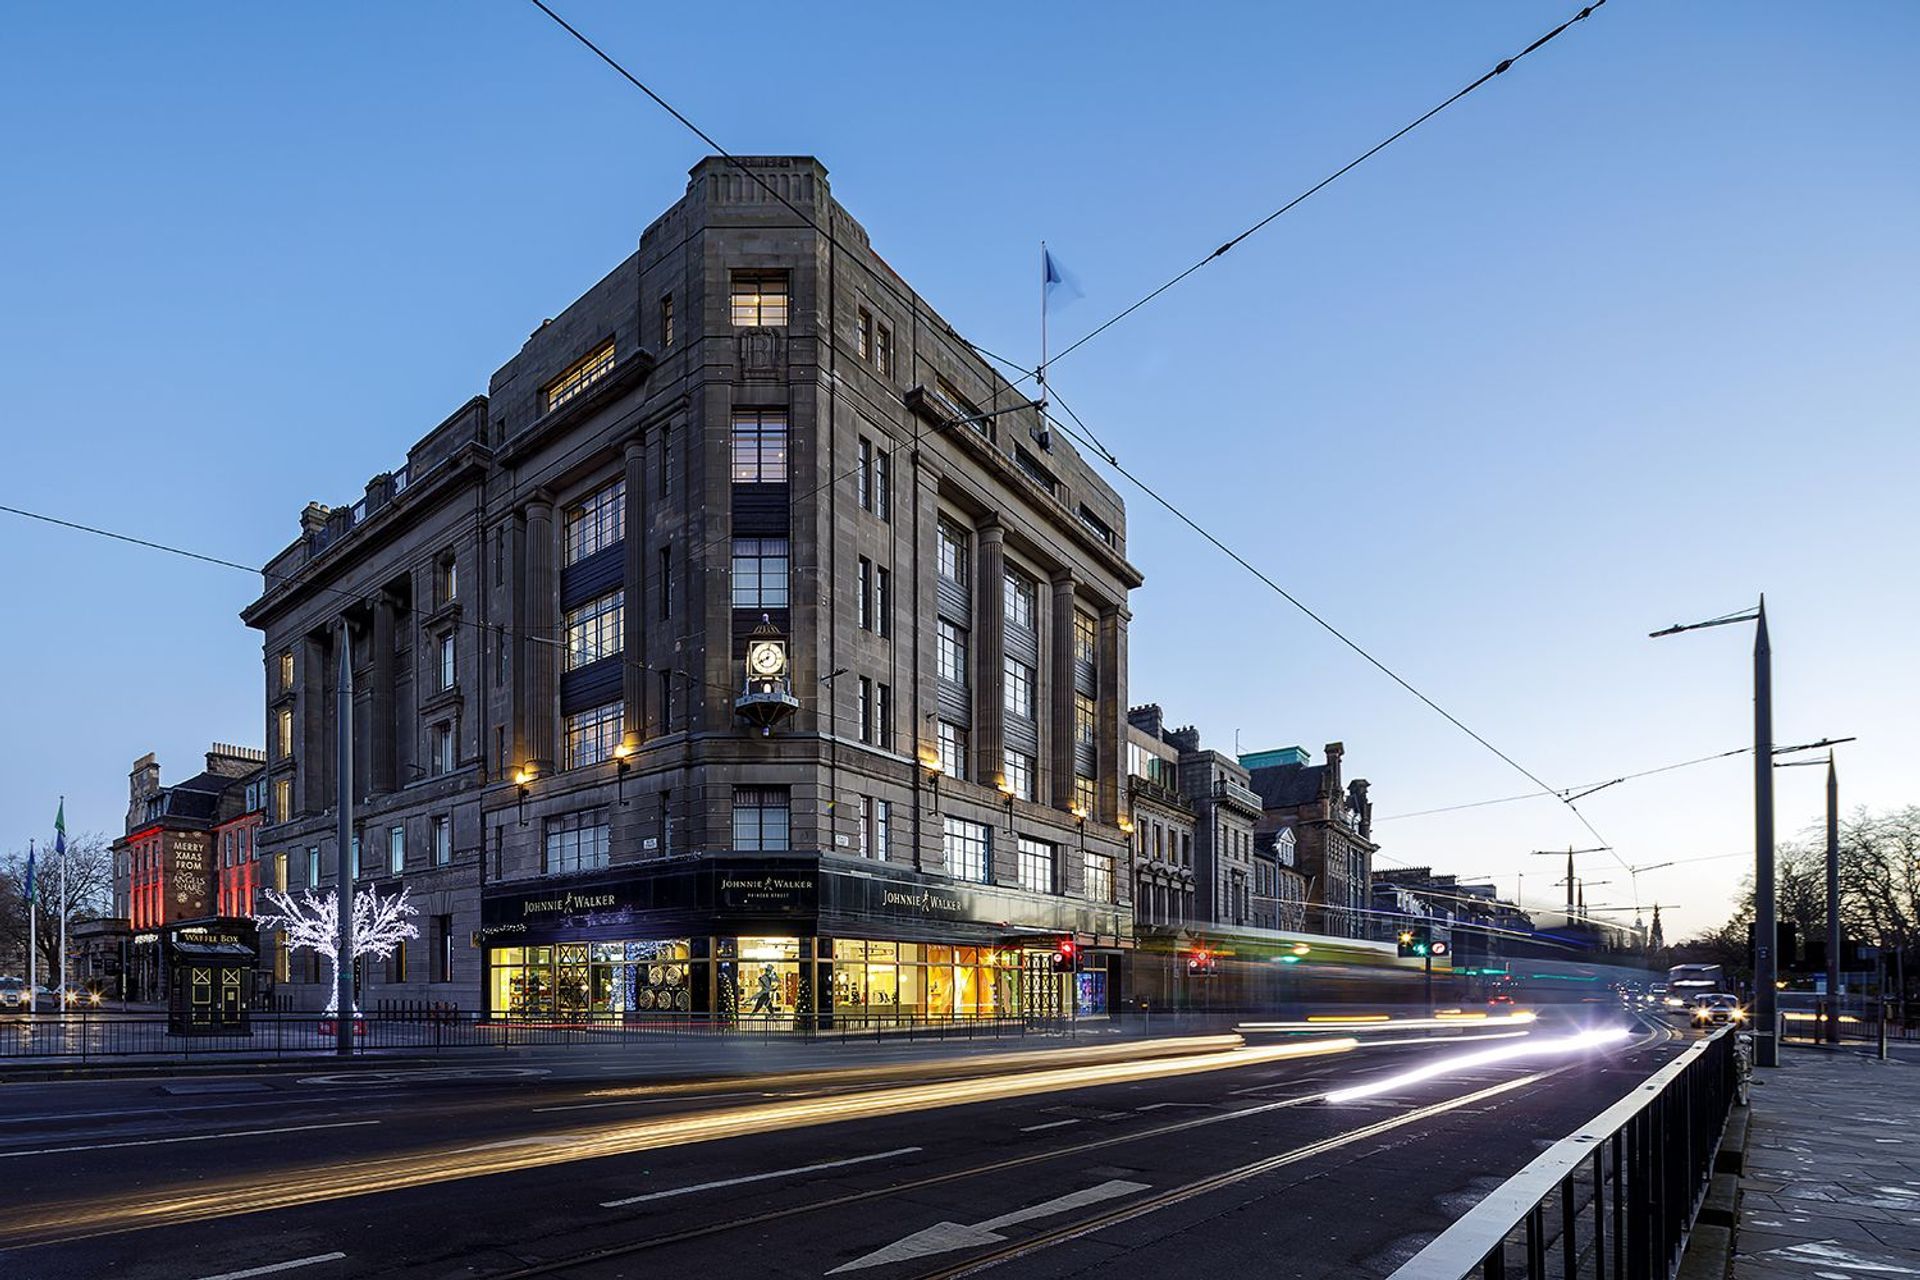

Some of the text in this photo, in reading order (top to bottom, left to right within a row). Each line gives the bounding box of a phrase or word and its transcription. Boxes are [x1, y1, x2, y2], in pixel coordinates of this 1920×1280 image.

[173, 842, 204, 852] MERRY
[175, 851, 202, 861] XMAS
[176, 861, 202, 870] FROM
[721, 880, 813, 890] JOHNNIE WALKER
[523, 894, 616, 916] JOHNNIE WALKER
[883, 890, 961, 911] JOHNNIE WALKER
[221, 935, 239, 943] BOX
